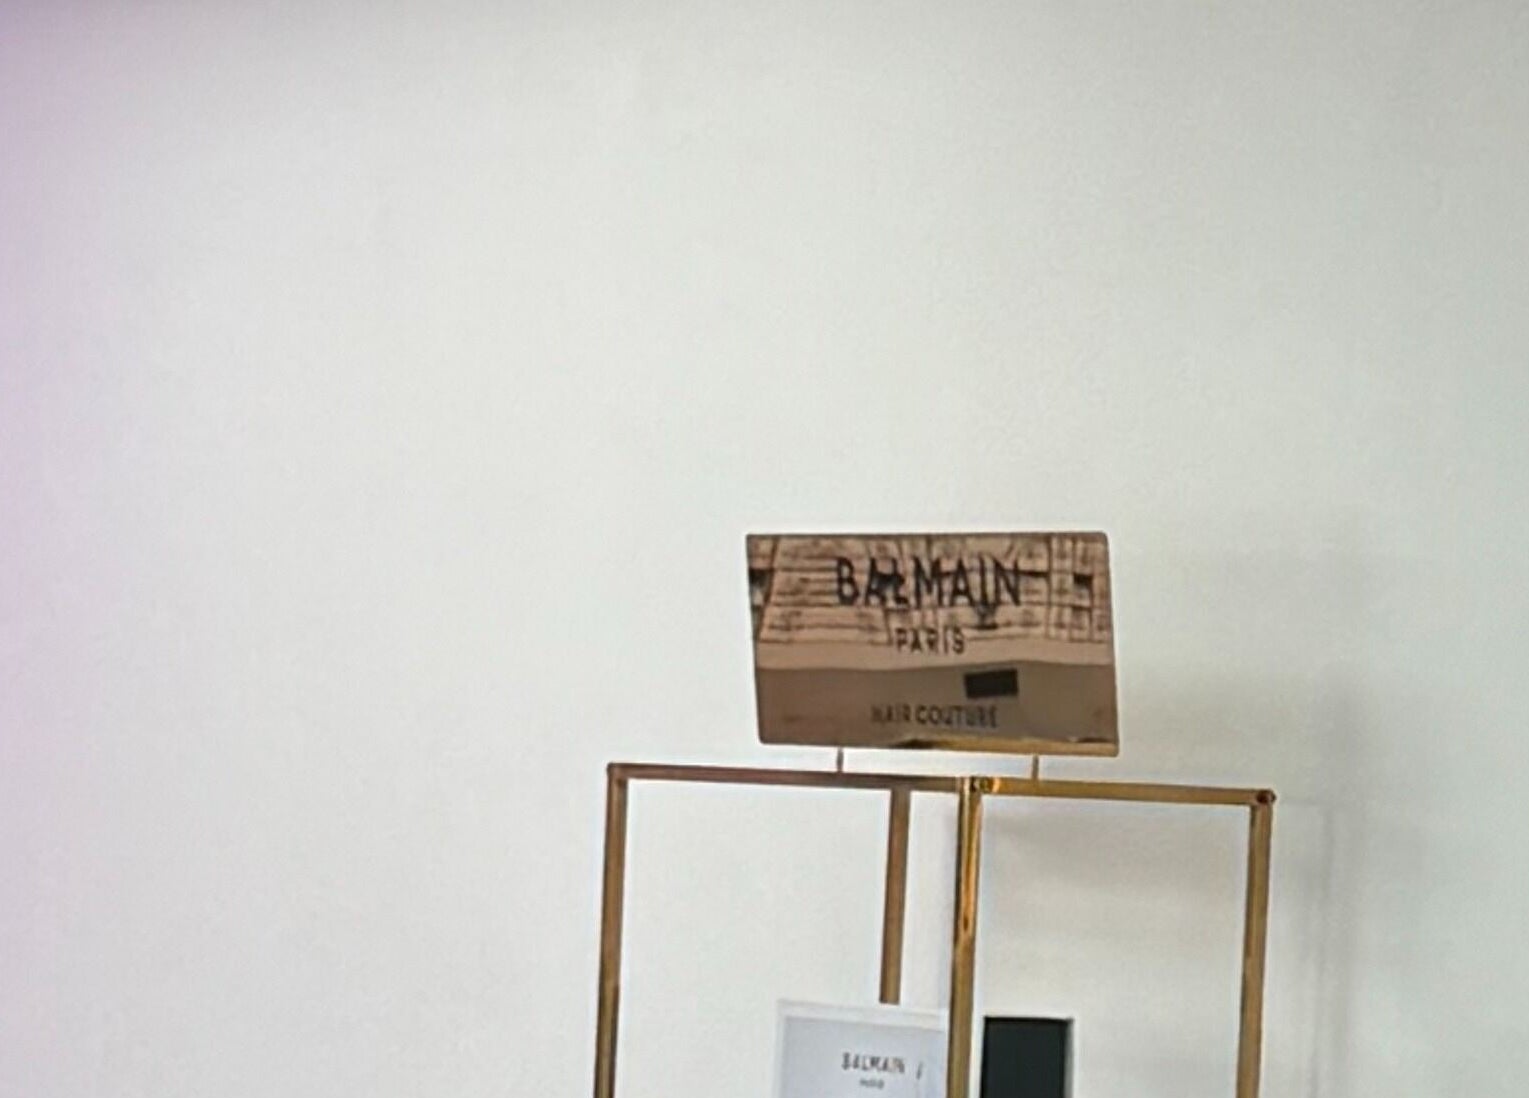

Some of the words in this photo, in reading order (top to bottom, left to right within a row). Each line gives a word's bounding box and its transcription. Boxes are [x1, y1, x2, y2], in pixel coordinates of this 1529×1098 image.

[836, 556, 1021, 608] BALMAIN
[896, 627, 965, 655] PARIS
[870, 703, 912, 723] HAIR
